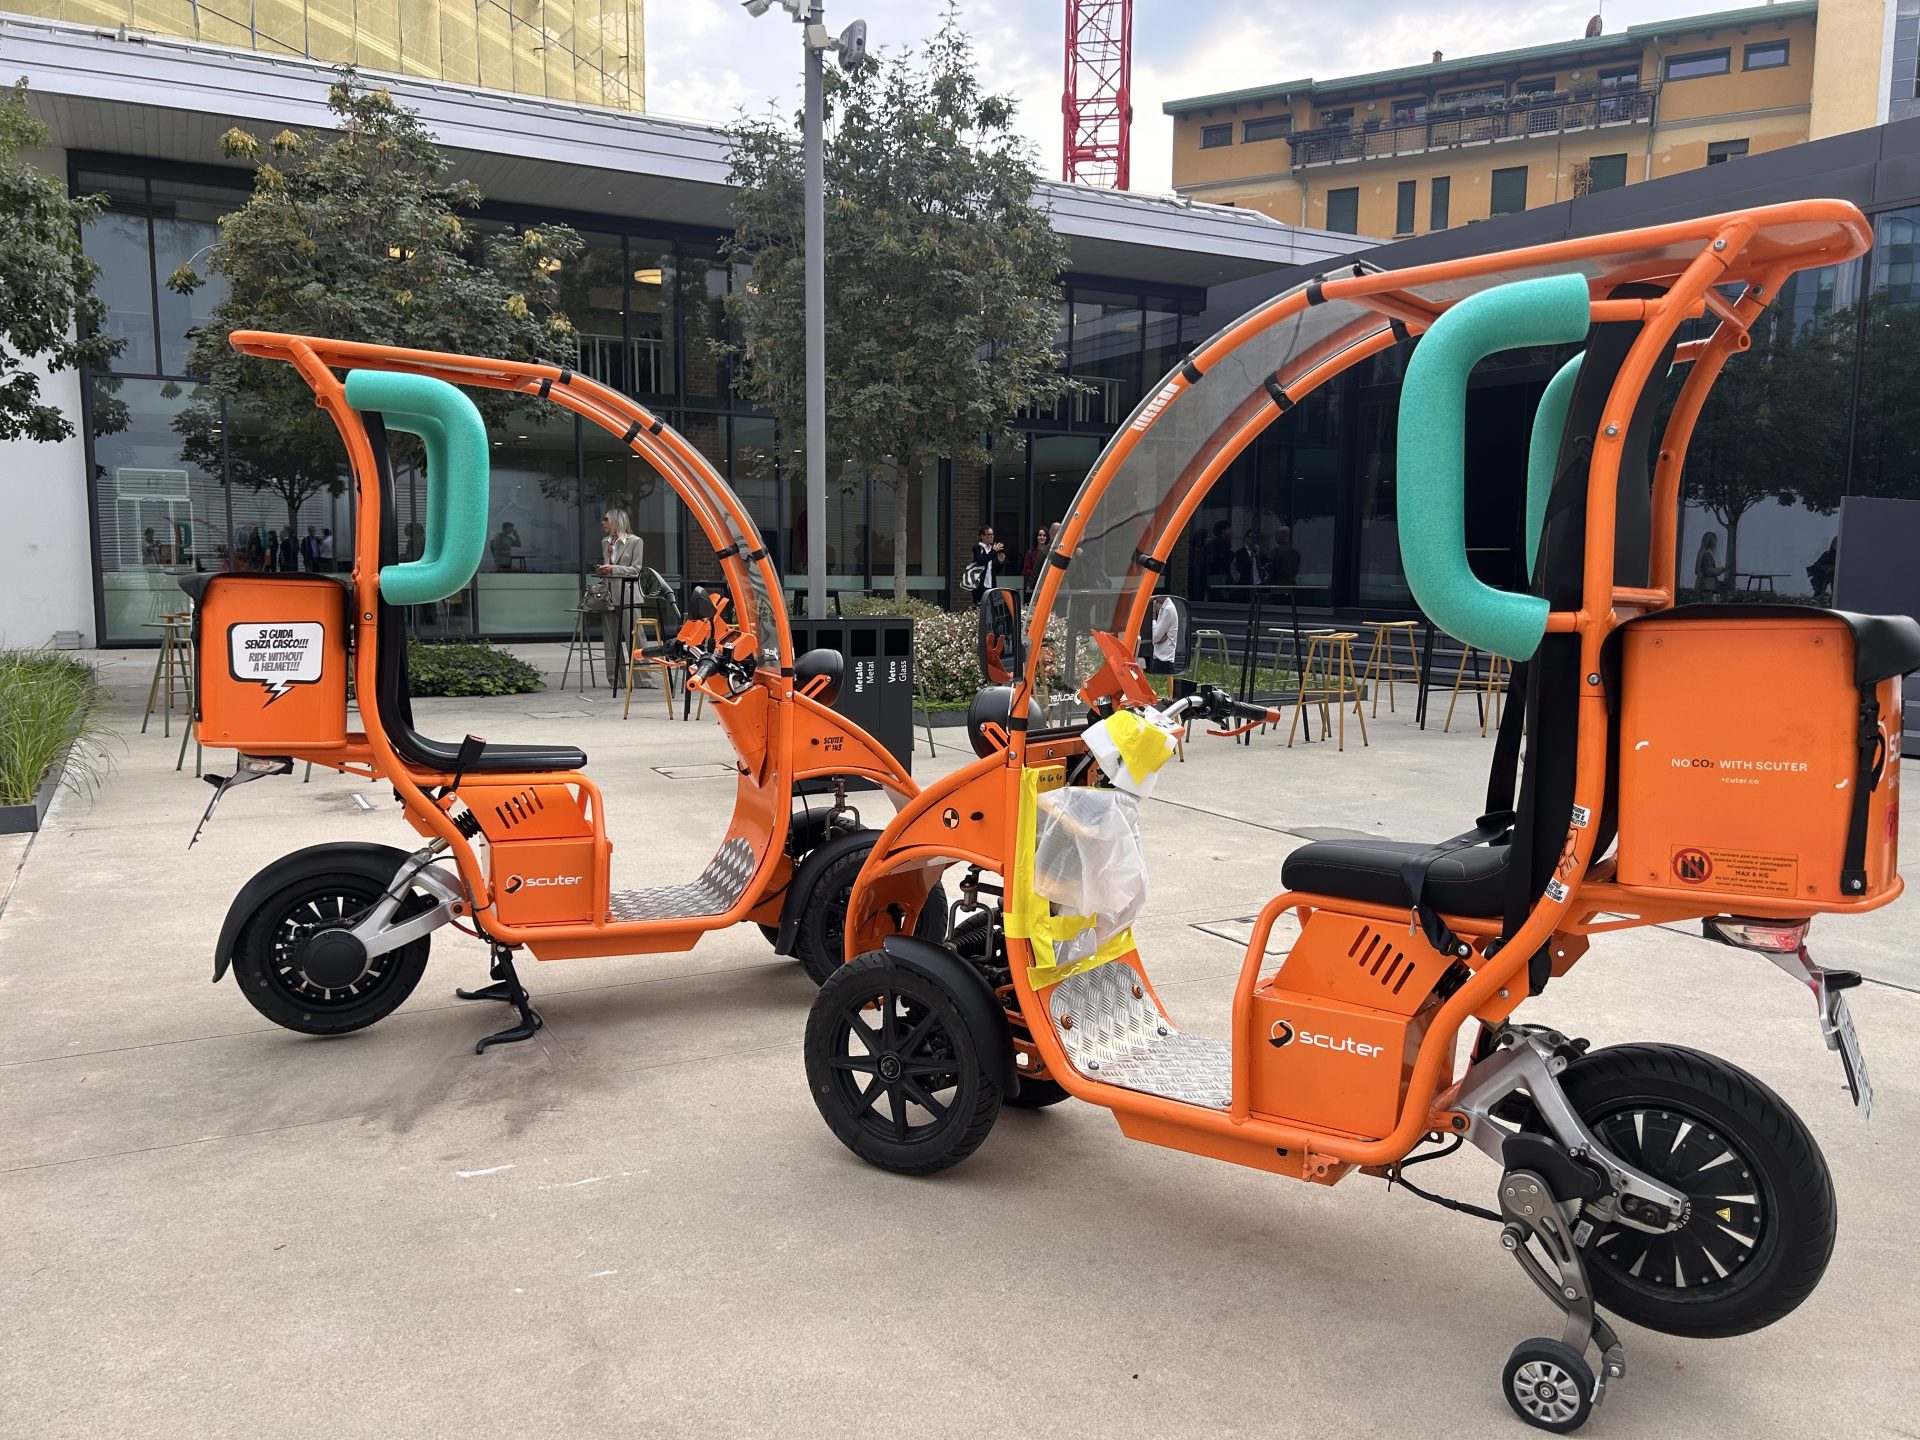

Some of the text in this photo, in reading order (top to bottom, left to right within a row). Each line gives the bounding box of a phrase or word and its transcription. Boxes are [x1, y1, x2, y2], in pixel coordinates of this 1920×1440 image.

[258, 628, 294, 640] SI GUIDA
[244, 638, 310, 650] SENZA CASCO!!!
[248, 651, 304, 662] RIDE WITHOUT
[253, 661, 300, 672] A HELMET!!!
[866, 661, 874, 684] Metal
[888, 660, 896, 683] Vetro
[898, 660, 907, 682] Glass
[854, 661, 864, 693] Metallo
[1719, 760, 1752, 769] WITH
[1755, 761, 1808, 772] SCUTER
[526, 875, 582, 887] scuter
[1300, 1031, 1384, 1058] scuter
